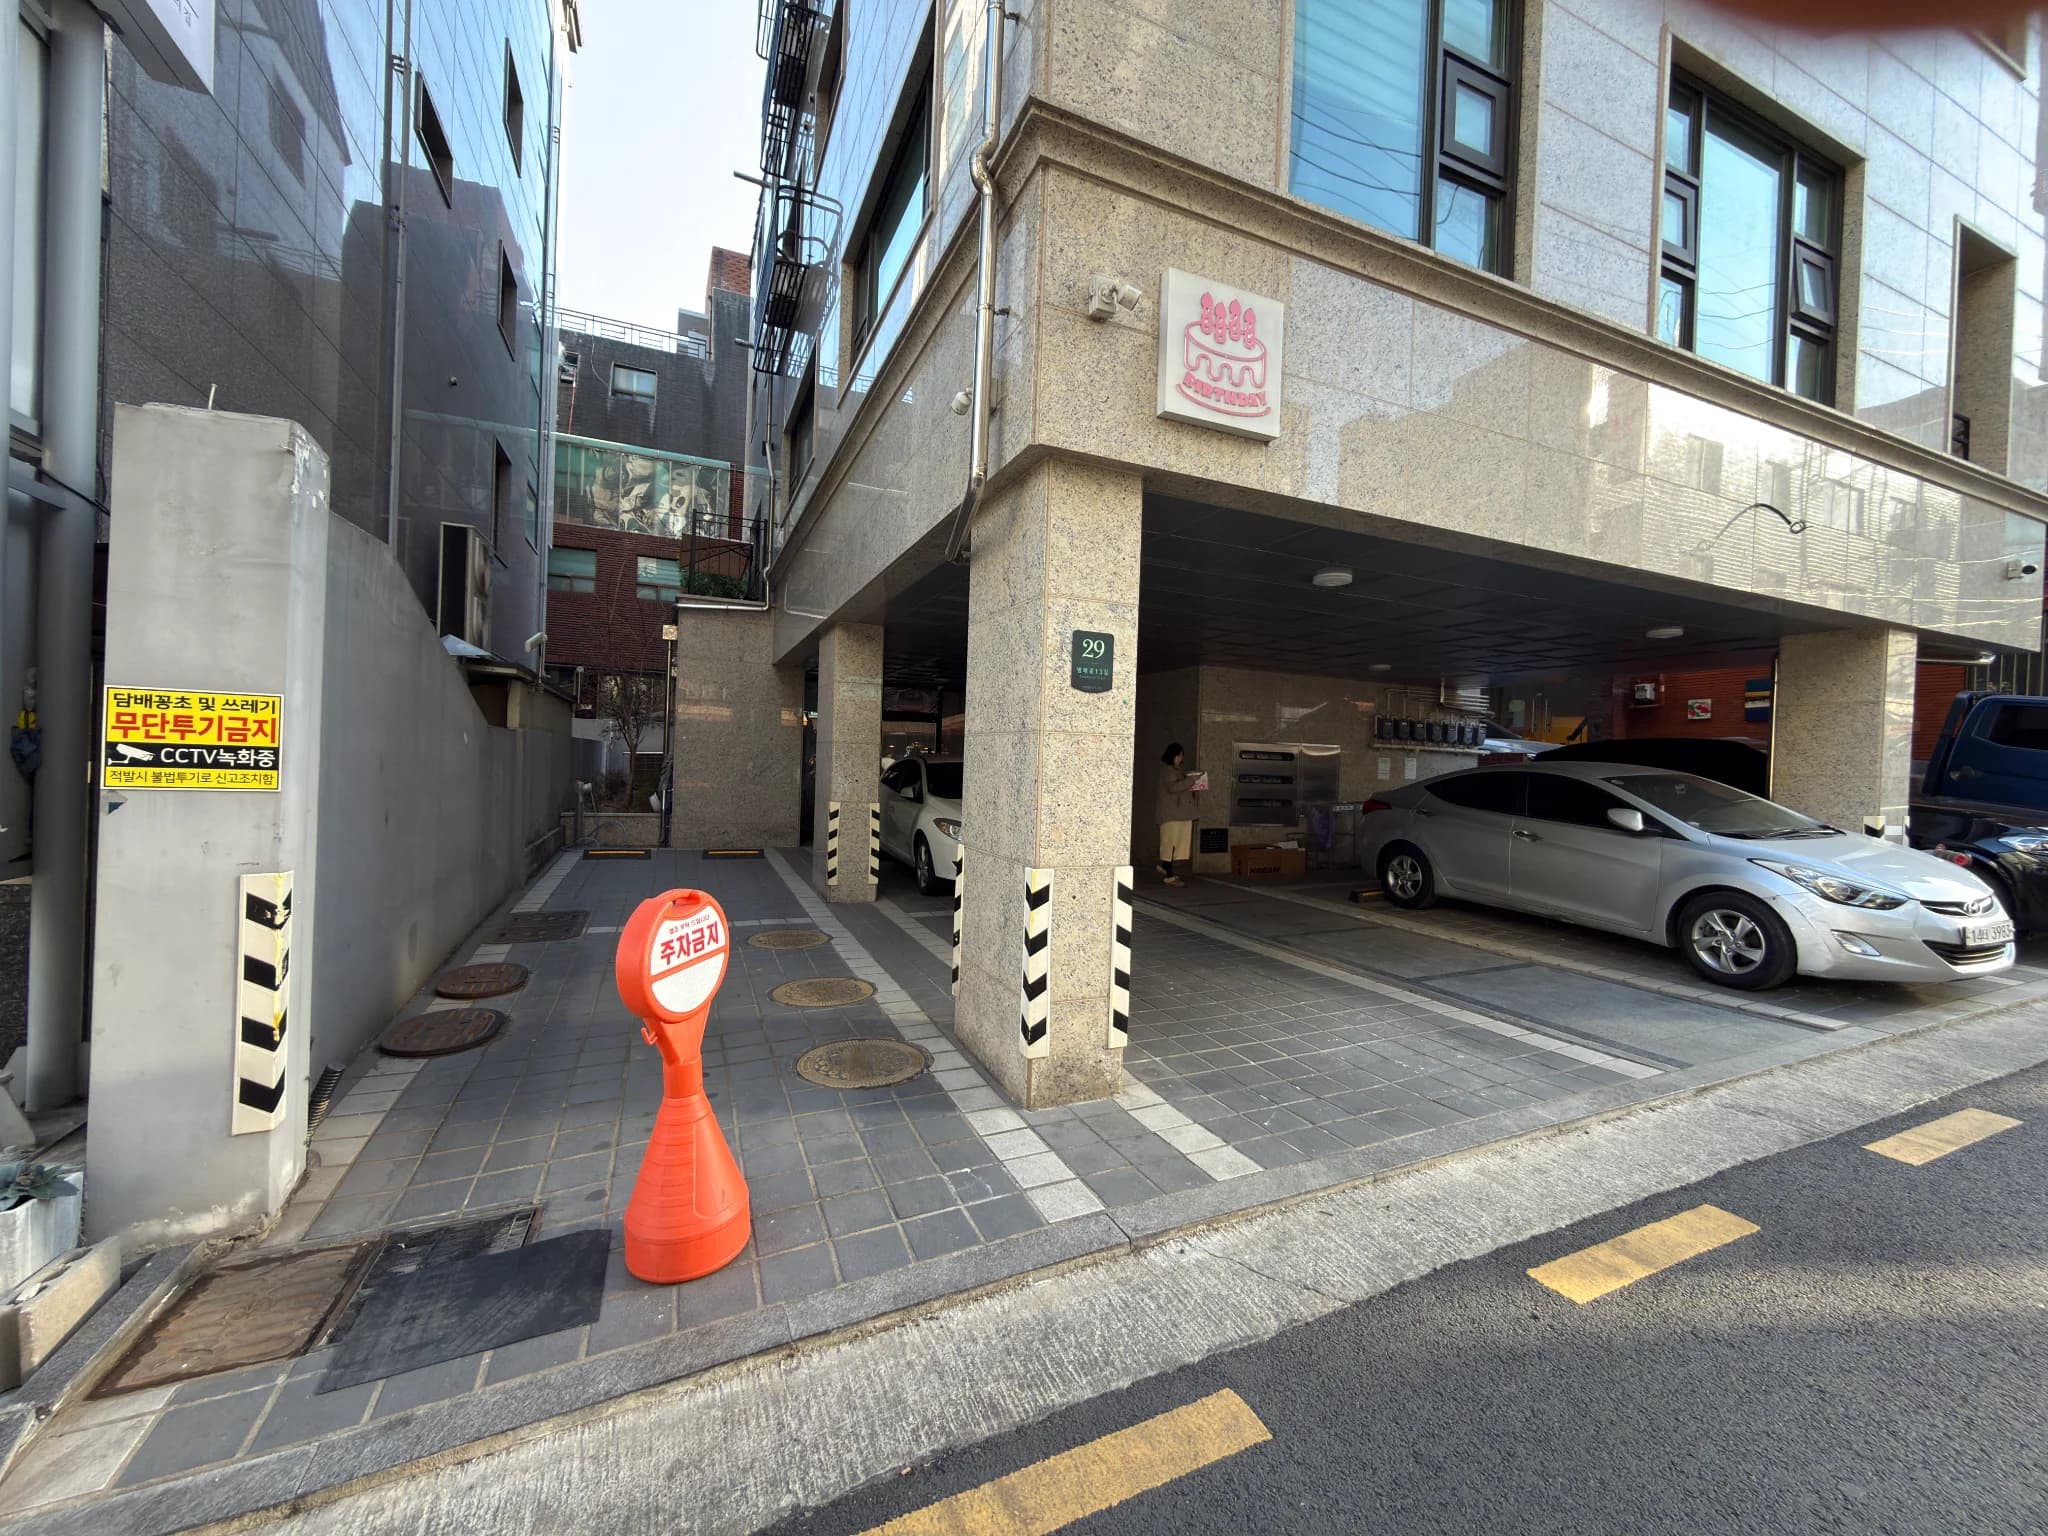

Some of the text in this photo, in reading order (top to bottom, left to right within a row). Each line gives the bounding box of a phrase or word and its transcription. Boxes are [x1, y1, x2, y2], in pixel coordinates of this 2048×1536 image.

[1183, 371, 1266, 407] BIRTHDAY
[1082, 638, 1105, 659] 29
[113, 693, 276, 714] 담배꽁초 및 쓰레기
[111, 712, 277, 743] 무단투기금지
[160, 747, 276, 767] CCTV녹화중
[111, 770, 274, 785] 적발시 불법투기로 신고조치함
[660, 921, 719, 966] 주차금지
